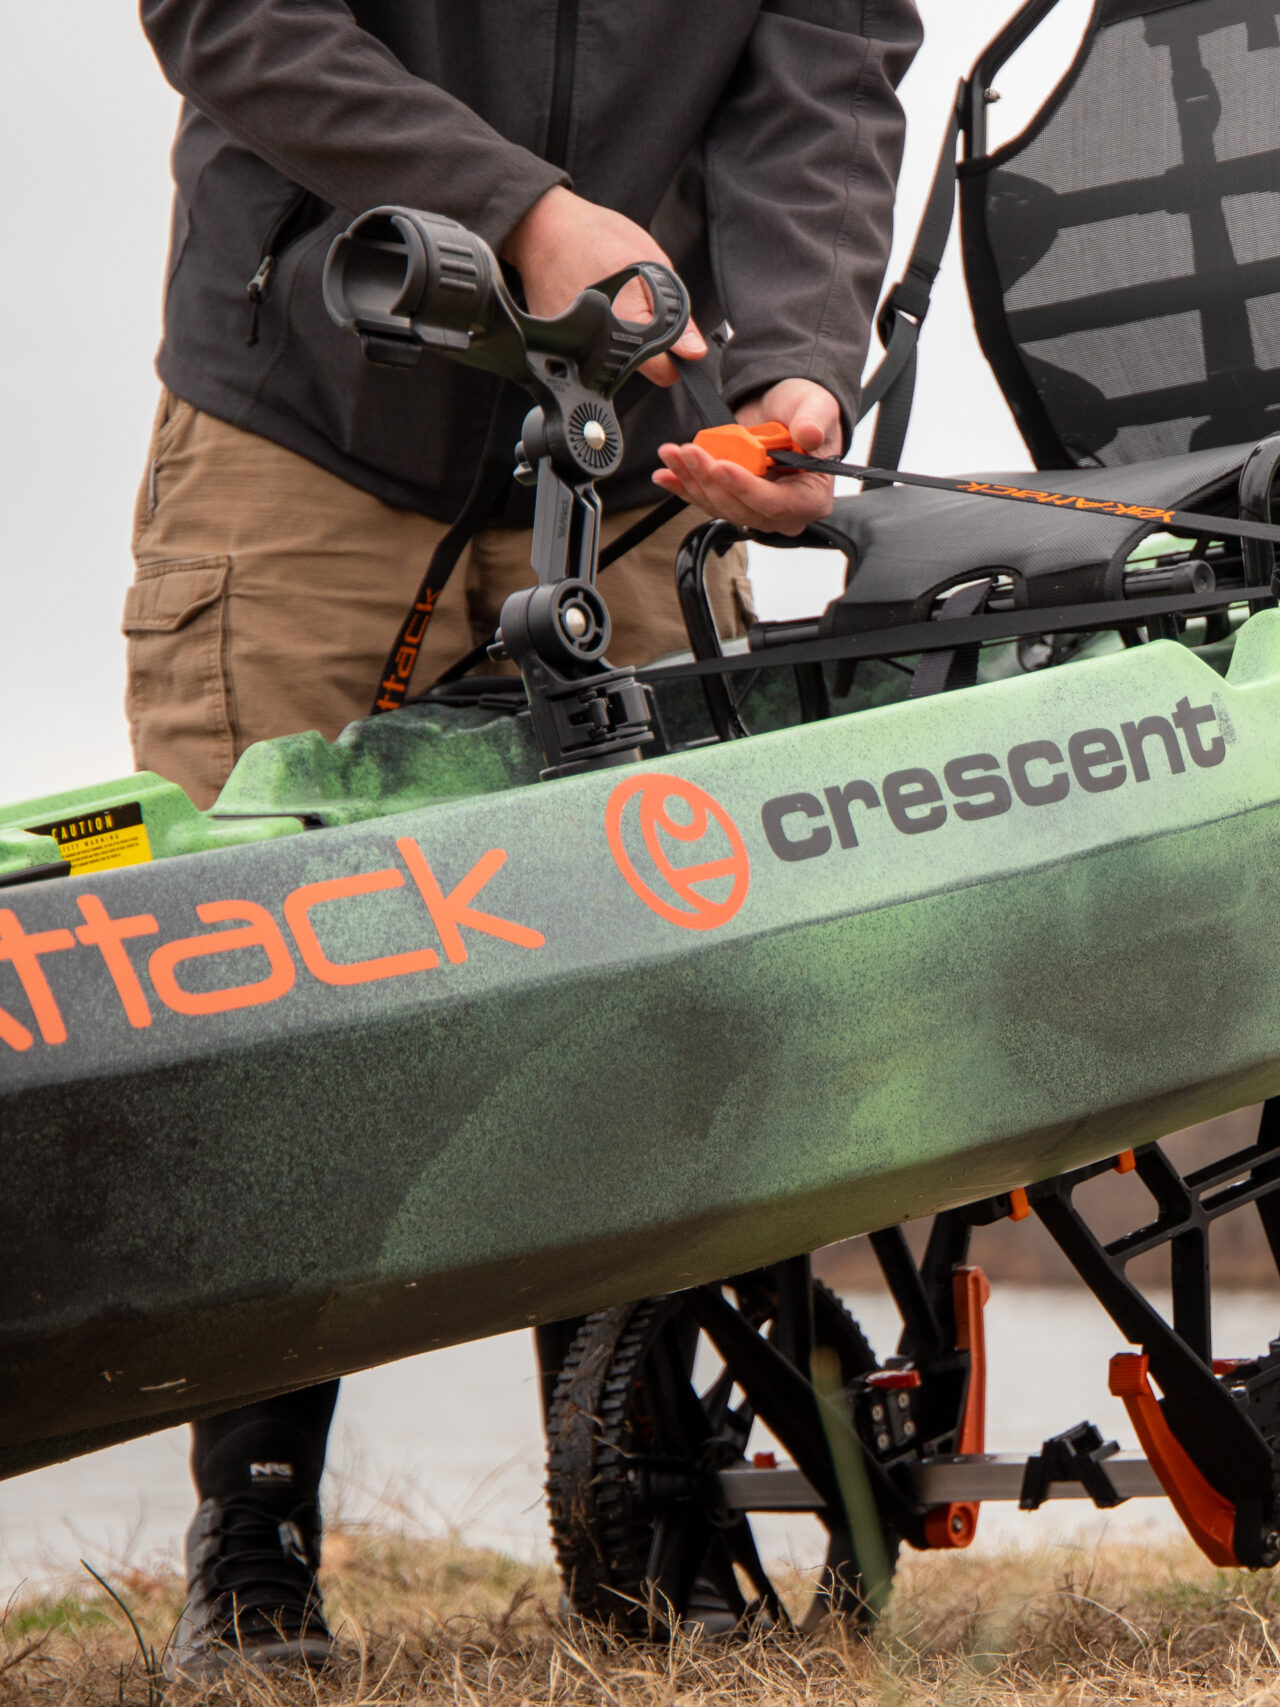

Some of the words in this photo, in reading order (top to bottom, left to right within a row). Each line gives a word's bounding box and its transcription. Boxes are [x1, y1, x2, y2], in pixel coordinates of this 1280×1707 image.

[955, 481, 1176, 523] YakAttack
[51, 814, 114, 840] CAUTION
[760, 695, 1227, 863] crescent
[0, 836, 546, 1052] ttack
